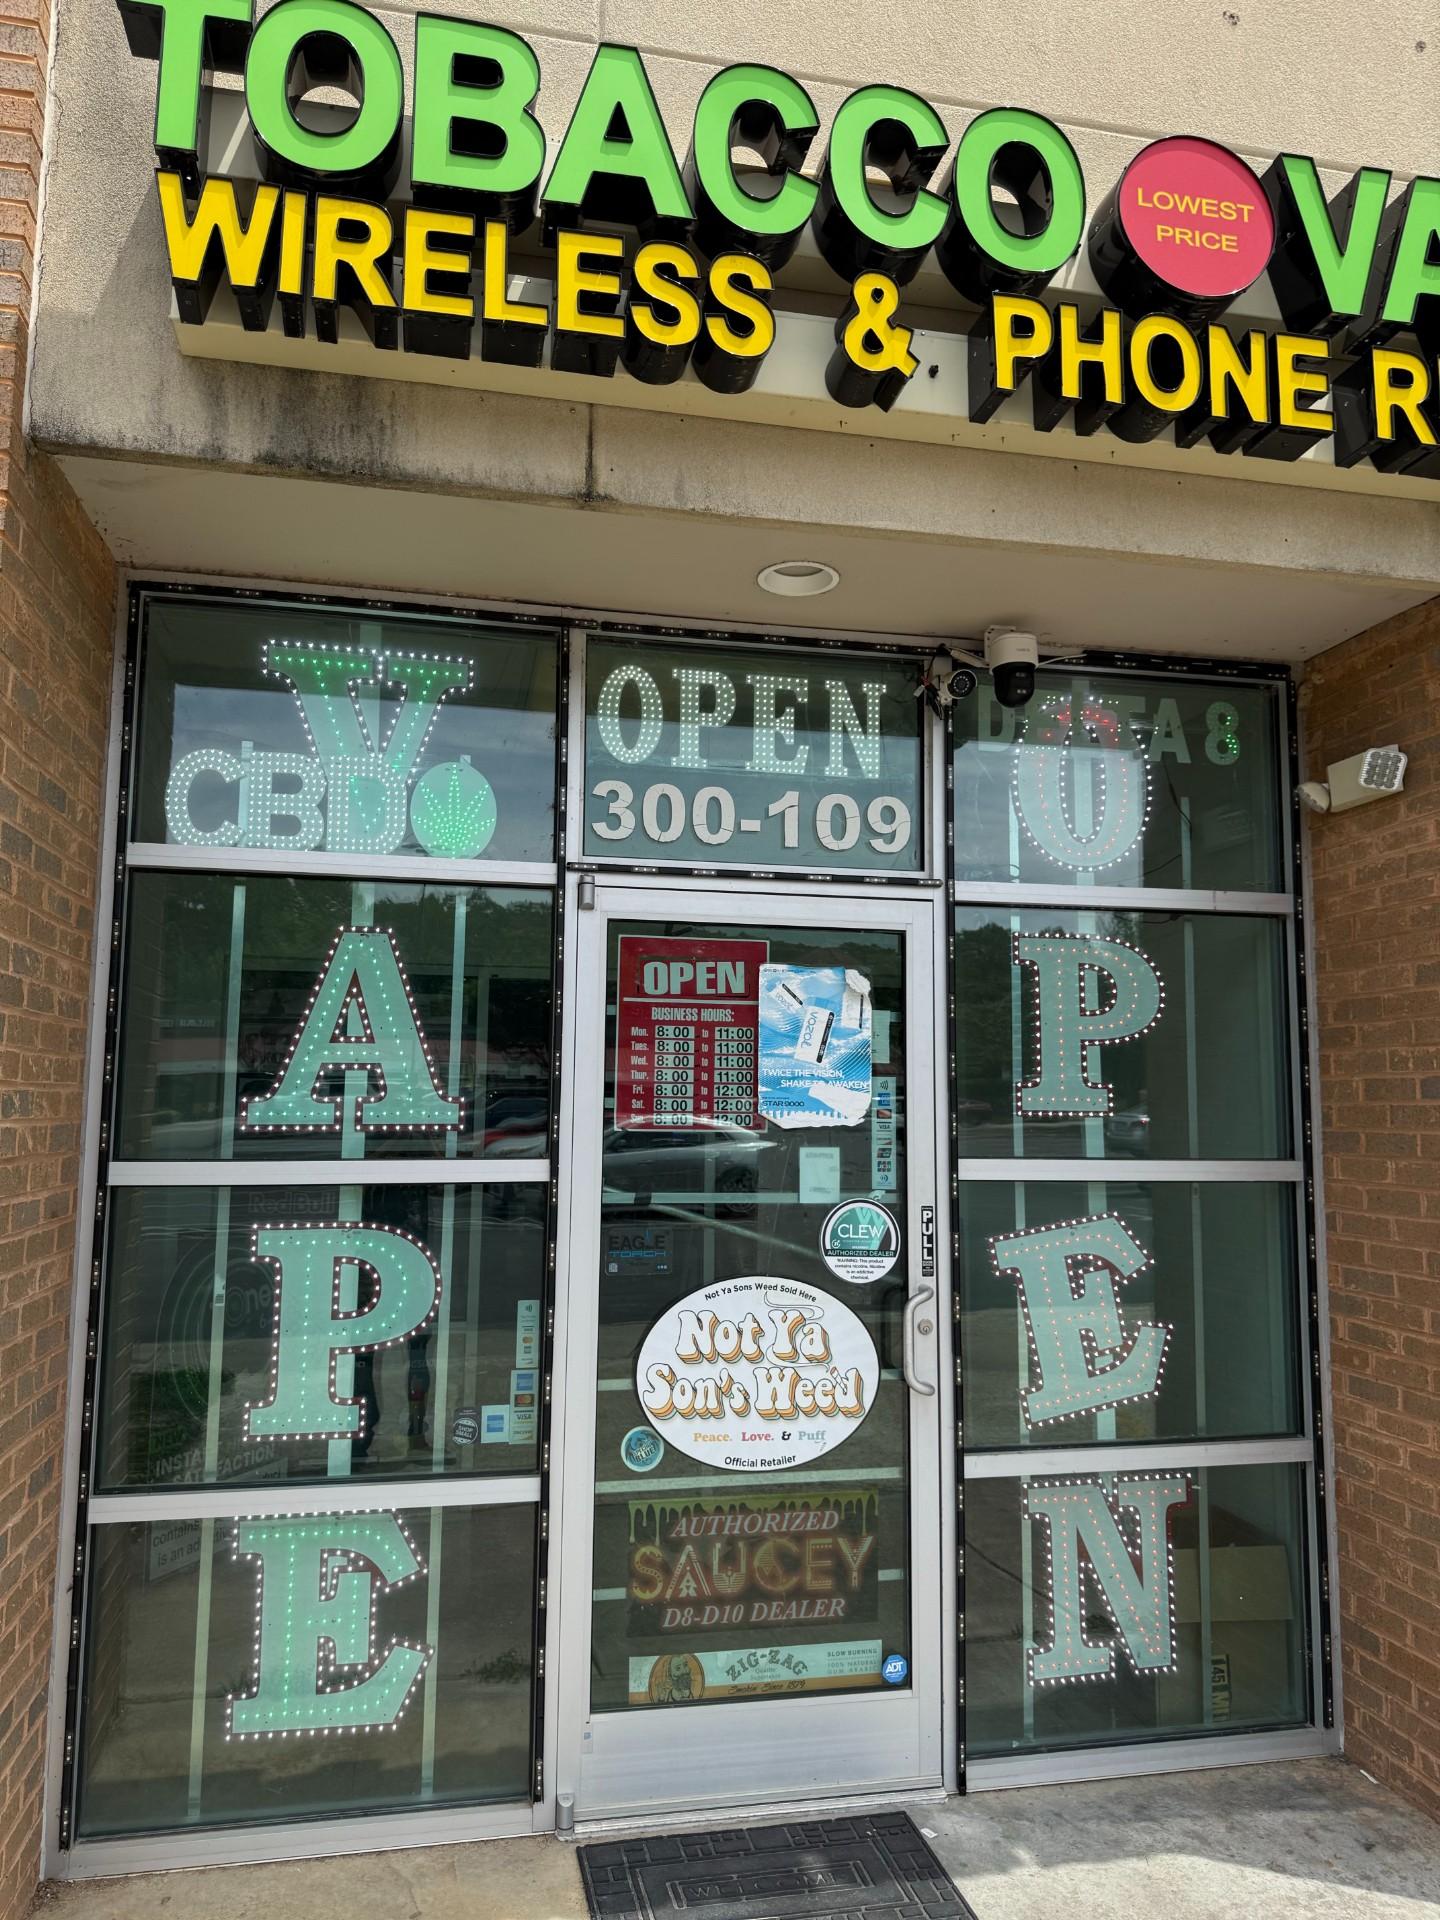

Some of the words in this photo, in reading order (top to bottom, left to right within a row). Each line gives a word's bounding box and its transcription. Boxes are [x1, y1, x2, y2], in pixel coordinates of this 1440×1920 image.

[121, 0, 1086, 272] TOBACCO
[1137, 186, 1255, 223] LOWEST
[1156, 224, 1239, 253] PRICE
[155, 168, 776, 359] WIRELESS
[842, 270, 920, 378] &
[993, 292, 1336, 432] PHONE
[1372, 346, 1440, 446] R
[598, 664, 887, 779] OPEN
[1205, 701, 1240, 766] 8
[165, 748, 406, 855] CBD
[591, 780, 912, 854] 300-109
[643, 961, 745, 996] OPEN
[651, 1007, 698, 1022] BUSINESS
[701, 1008, 735, 1023] HOURS:
[630, 1026, 649, 1037] Mon.
[702, 1029, 709, 1038] to
[717, 1028, 753, 1039] 11:00
[630, 1041, 649, 1051] Tues.
[702, 1043, 709, 1052] to
[717, 1043, 753, 1054] 11:00
[630, 1055, 649, 1066] Wed.
[702, 1057, 709, 1067] to
[717, 1057, 753, 1068] 11:00
[630, 1070, 649, 1080] Thur.
[701, 1072, 708, 1081] to
[717, 1071, 753, 1083] 11:00
[762, 1068, 793, 1077] TWICE
[795, 1069, 812, 1078] THE
[781, 1079, 811, 1088] SHAKE
[632, 1084, 645, 1095] Fri.
[701, 1086, 708, 1096] to
[715, 1085, 753, 1097] 12:00
[631, 1099, 646, 1109] Sat.
[700, 1101, 708, 1110] to
[714, 1099, 752, 1112] 12:00
[838, 1224, 884, 1239] CLEW
[922, 1210, 933, 1261] PULL
[705, 1290, 720, 1301] Not
[721, 1287, 732, 1295] Ya
[733, 1283, 753, 1292] Sons
[754, 1282, 778, 1291] Weed
[780, 1285, 797, 1295] Sold
[798, 1290, 817, 1303] Here
[675, 1309, 765, 1364] Not
[767, 1309, 832, 1364] Ya
[643, 1362, 751, 1420] Son's
[693, 1432, 733, 1442] Peace.
[741, 1431, 775, 1442] Love.
[781, 1430, 792, 1441] &
[798, 1430, 827, 1441] Puff
[724, 1456, 758, 1468] Official
[760, 1455, 797, 1468] Retailer
[671, 1510, 839, 1538] AUTHORIZED
[631, 1535, 874, 1600] SAUCEY
[663, 1604, 744, 1629] D8-D10
[751, 1598, 847, 1623] DEALER
[725, 1648, 809, 1682] ZIG-ZAG
[847, 1648, 878, 1656] BURNING
[886, 1662, 904, 1673] ADT
